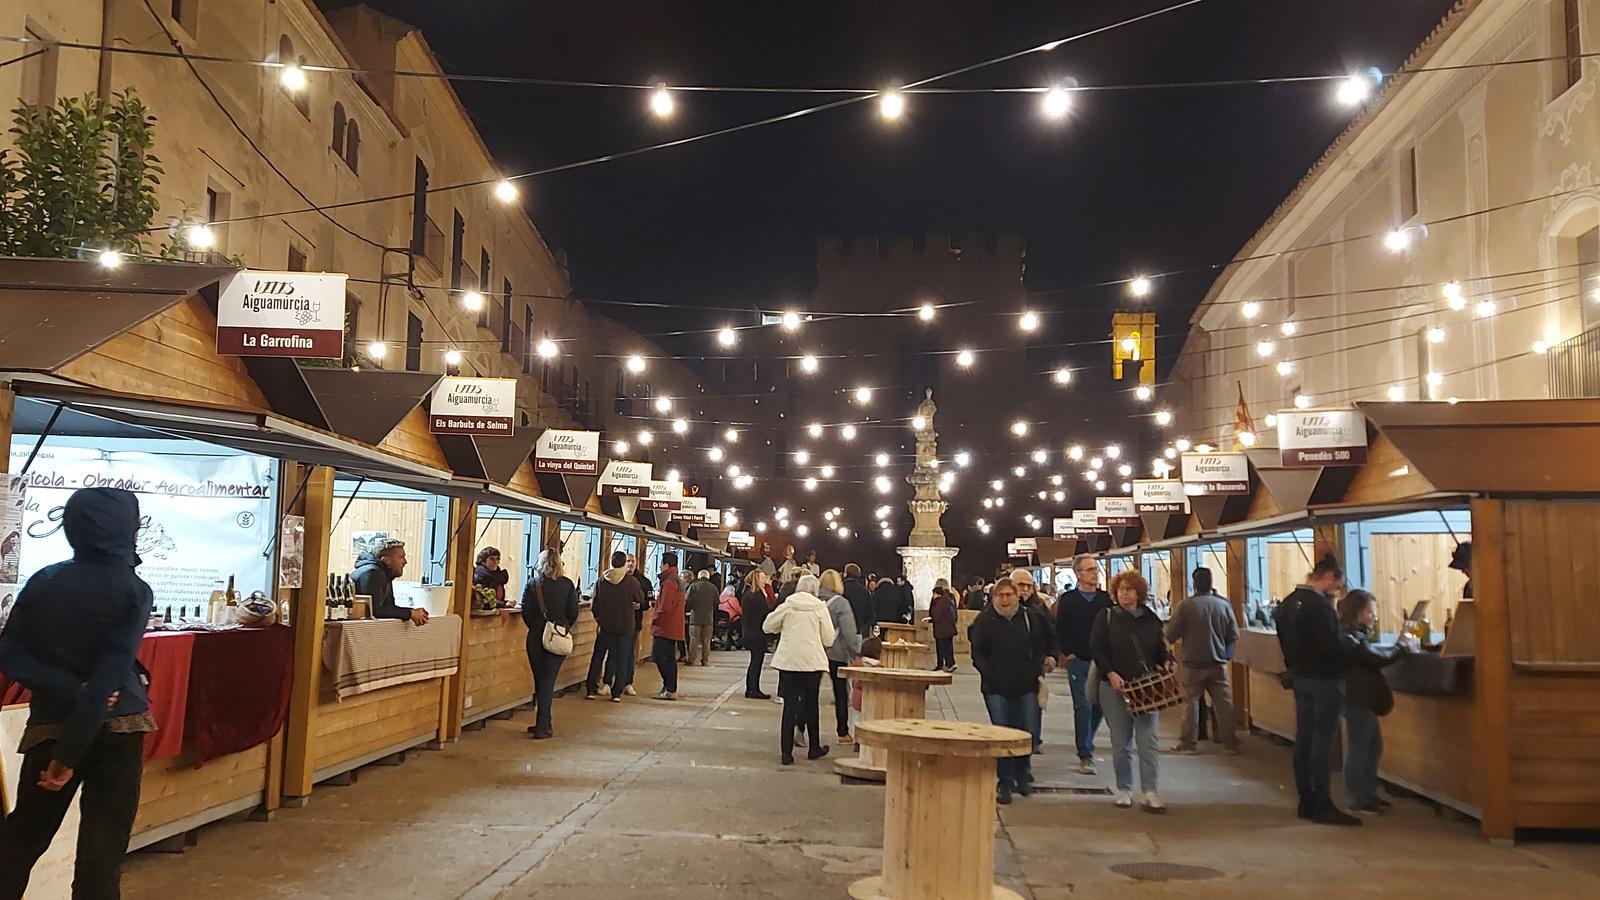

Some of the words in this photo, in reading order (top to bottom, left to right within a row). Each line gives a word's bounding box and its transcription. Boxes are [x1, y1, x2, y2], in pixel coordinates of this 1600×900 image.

[243, 333, 256, 347] La
[260, 333, 313, 349] Garrofina
[435, 419, 446, 427] Els
[448, 419, 475, 429] Barbuts
[476, 420, 485, 429] de
[486, 420, 508, 430] Selma
[562, 461, 572, 469] del
[30, 471, 65, 486] ícola
[83, 473, 151, 490] Obrador
